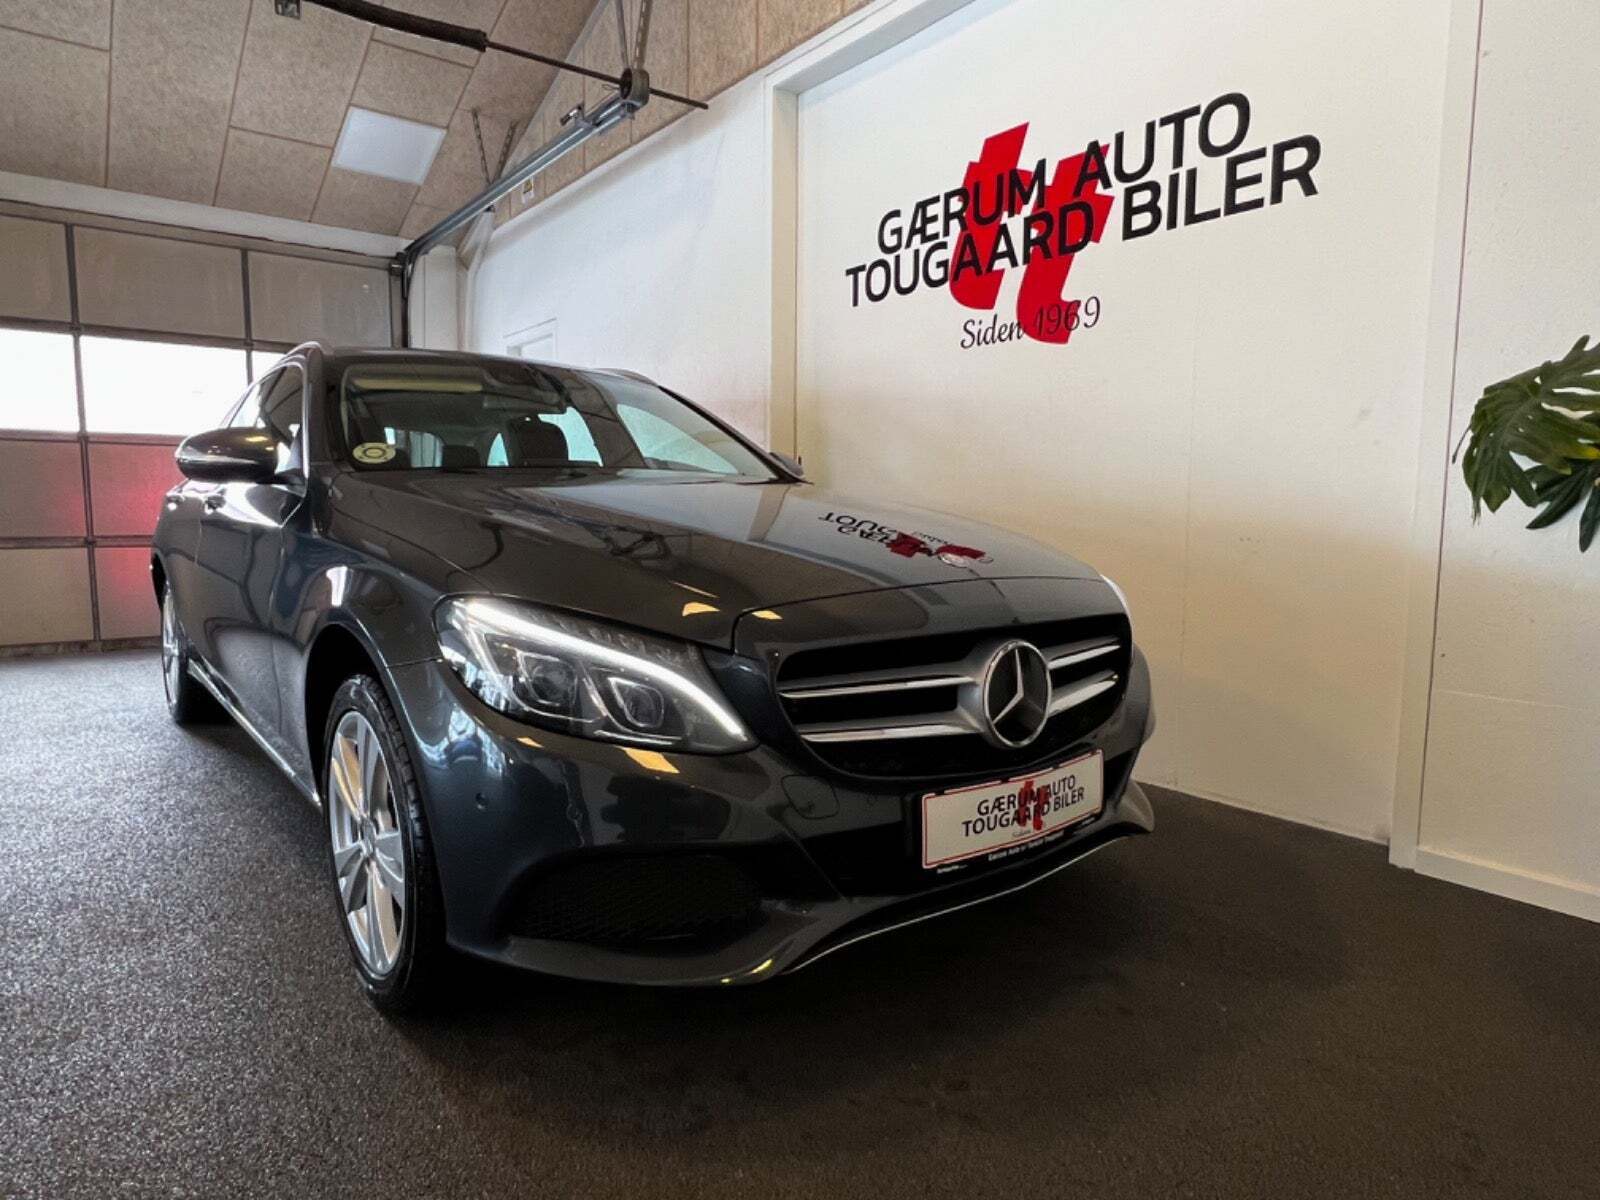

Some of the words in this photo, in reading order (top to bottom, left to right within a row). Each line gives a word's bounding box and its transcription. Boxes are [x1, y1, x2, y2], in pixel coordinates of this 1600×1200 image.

[845, 201, 1094, 308] TOUGAARD
[1122, 134, 1322, 241] BILER
[878, 158, 1046, 255] GÆRUM
[1073, 91, 1251, 197] AUTO
[960, 311, 1027, 349] Siden
[1034, 296, 1101, 337] 1969
[1053, 786, 1085, 812] BILER
